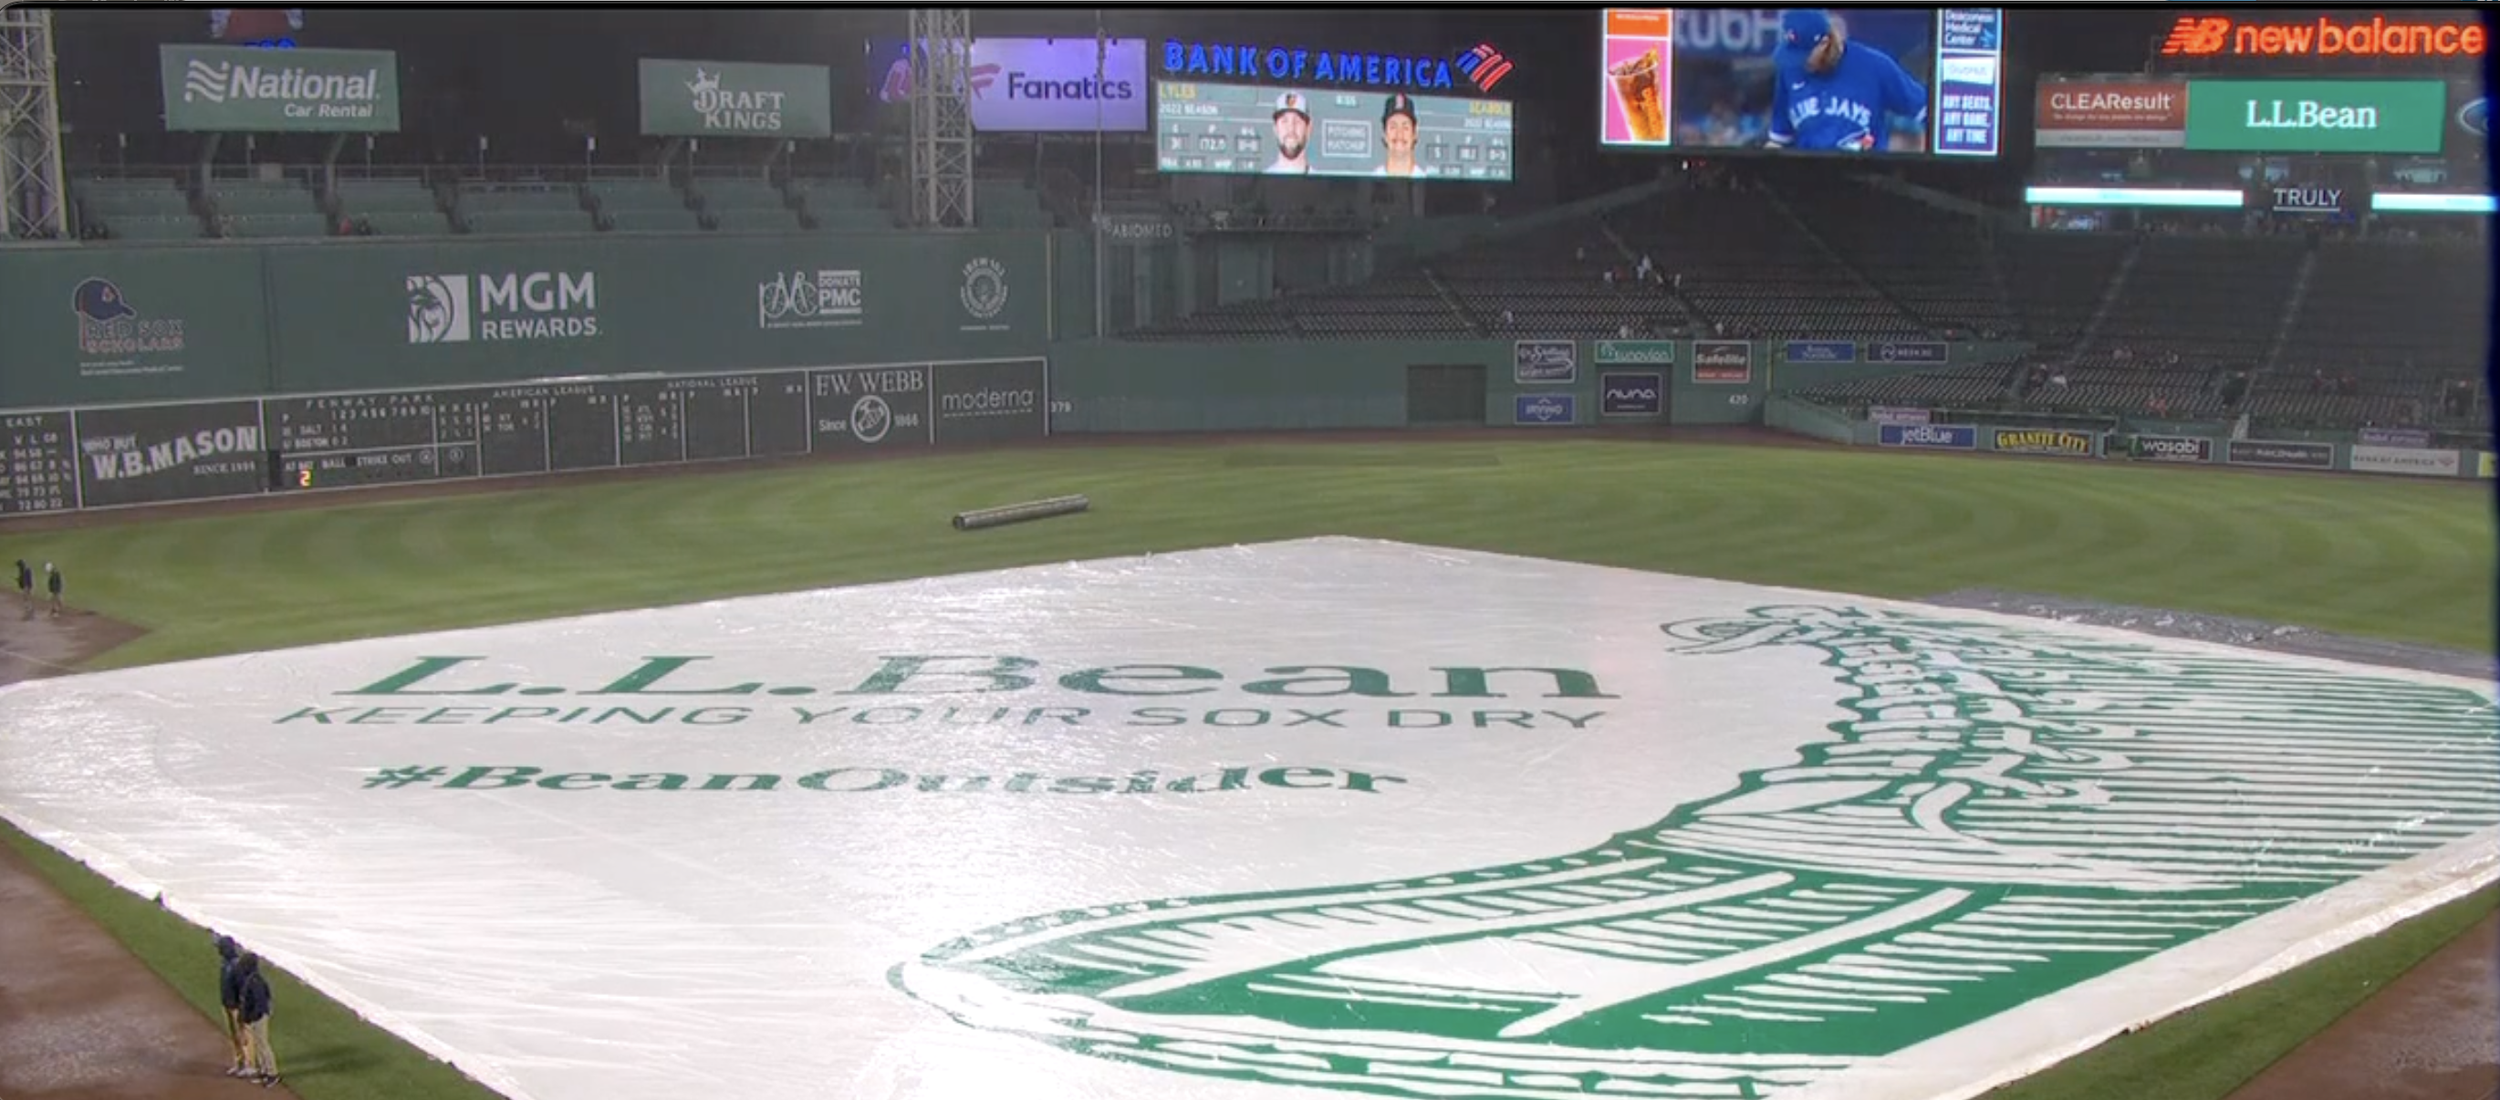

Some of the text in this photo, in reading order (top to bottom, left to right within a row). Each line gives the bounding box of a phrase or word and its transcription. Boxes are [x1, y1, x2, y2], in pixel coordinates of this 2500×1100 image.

[2234, 26, 2314, 55] new
[2317, 17, 2486, 55] balance
[1163, 38, 1453, 89] BANK OF AMERICA
[229, 66, 378, 100] National
[1008, 72, 1132, 100] Fanatics
[285, 103, 373, 118] Car Rental
[696, 88, 785, 113] DRAFT
[1824, 96, 1872, 127] JAYS
[2051, 92, 2171, 110] CLEAResult
[704, 108, 783, 131] KINGS
[2246, 100, 2377, 128] L.L.Bean
[2273, 188, 2342, 207] TRULY
[1110, 222, 1173, 239] ABIOMED
[480, 272, 596, 313] MGM
[819, 289, 862, 307] PMC
[87, 318, 184, 340] RED SOX
[482, 317, 598, 341] REWARDS
[1695, 351, 1748, 367] Safelite
[859, 370, 925, 394] WEBB
[306, 394, 434, 410] FENWAY PARK
[942, 386, 1035, 412] moderna
[6, 415, 43, 429] EAST
[819, 418, 847, 434] Since
[1900, 425, 1954, 446] jetBlue
[1996, 430, 2089, 454] GRANITE CITY
[2142, 436, 2201, 455] wasabi
[92, 426, 259, 481] W.B.MASON
[192, 464, 229, 477] SINCE
[332, 655, 1621, 700] L.L.Bean
[273, 705, 1608, 730] KEEPING YOUR SOX DRY
[360, 764, 1408, 794] #BeanOutsider
